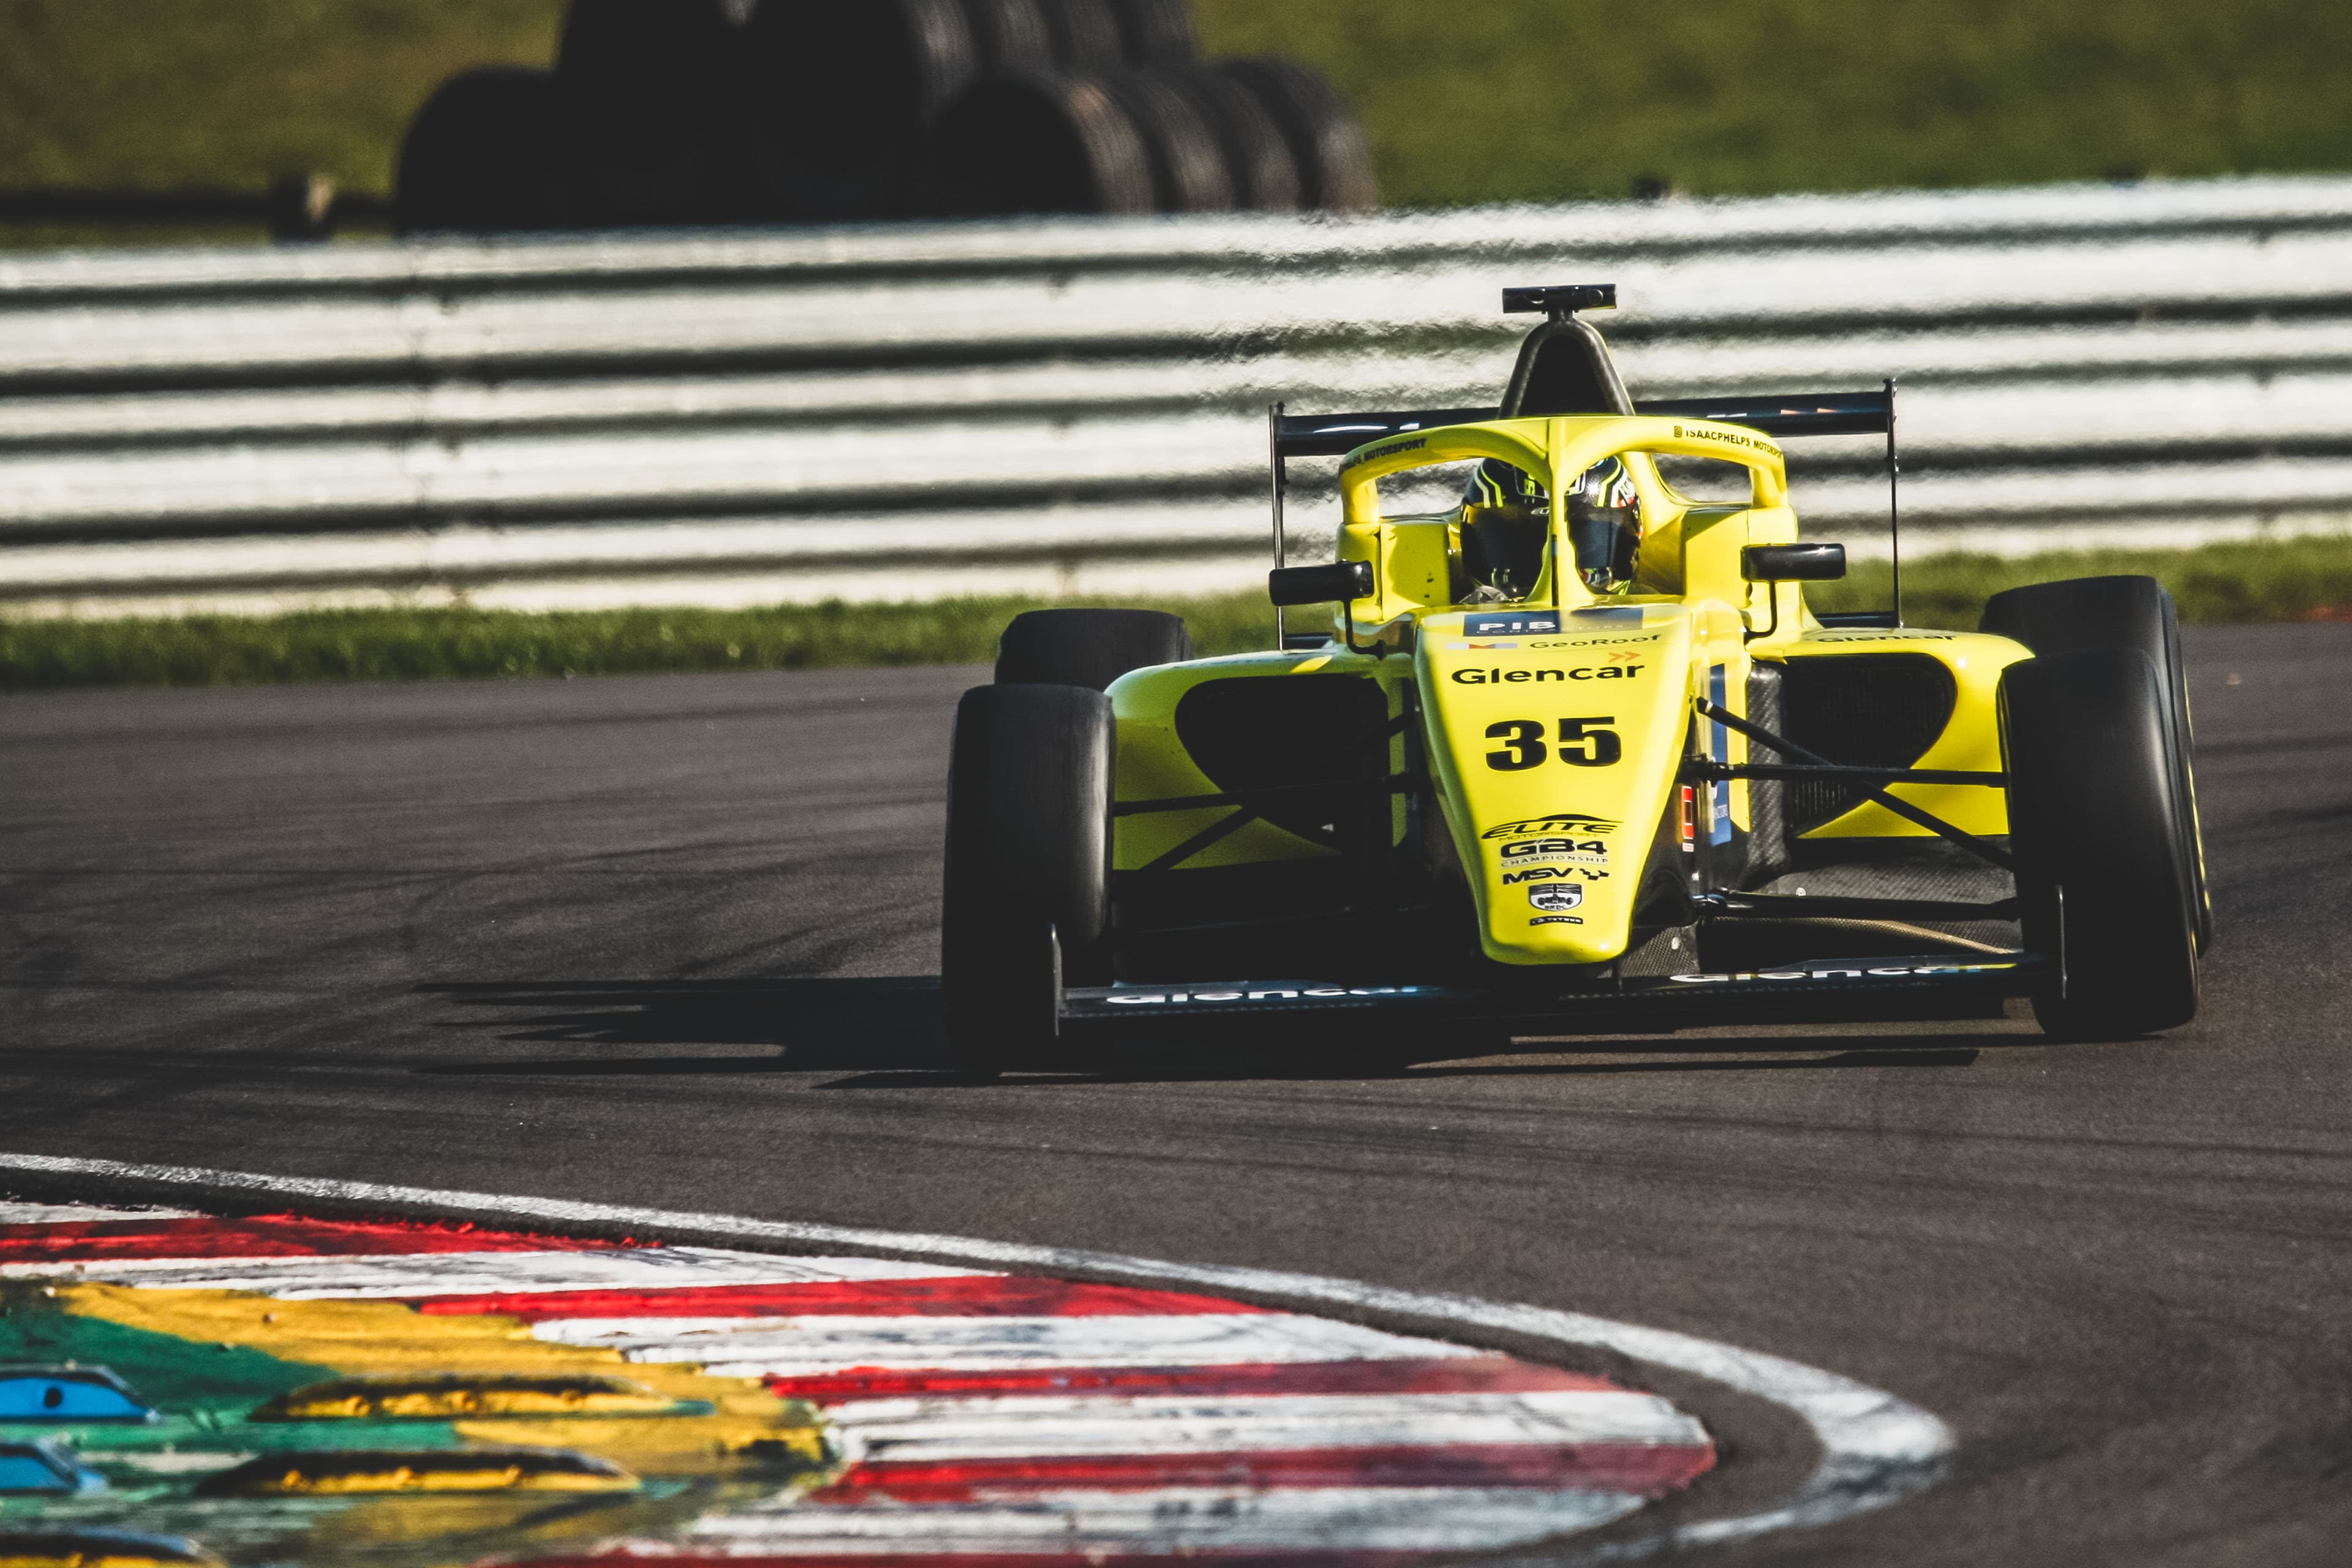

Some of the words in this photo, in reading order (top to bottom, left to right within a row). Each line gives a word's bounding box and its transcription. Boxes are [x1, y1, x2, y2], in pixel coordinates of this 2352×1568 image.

[1686, 429, 1750, 447] ISAACPHELPS
[1479, 621, 1556, 631] PIB
[1451, 664, 1645, 684] Glencar
[1485, 716, 1622, 772] 35
[1481, 821, 1618, 840] ELITE
[1501, 838, 1608, 858] GB4
[1501, 855, 1608, 867] CHAMPIONSHIP
[1502, 867, 1574, 885] MSV
